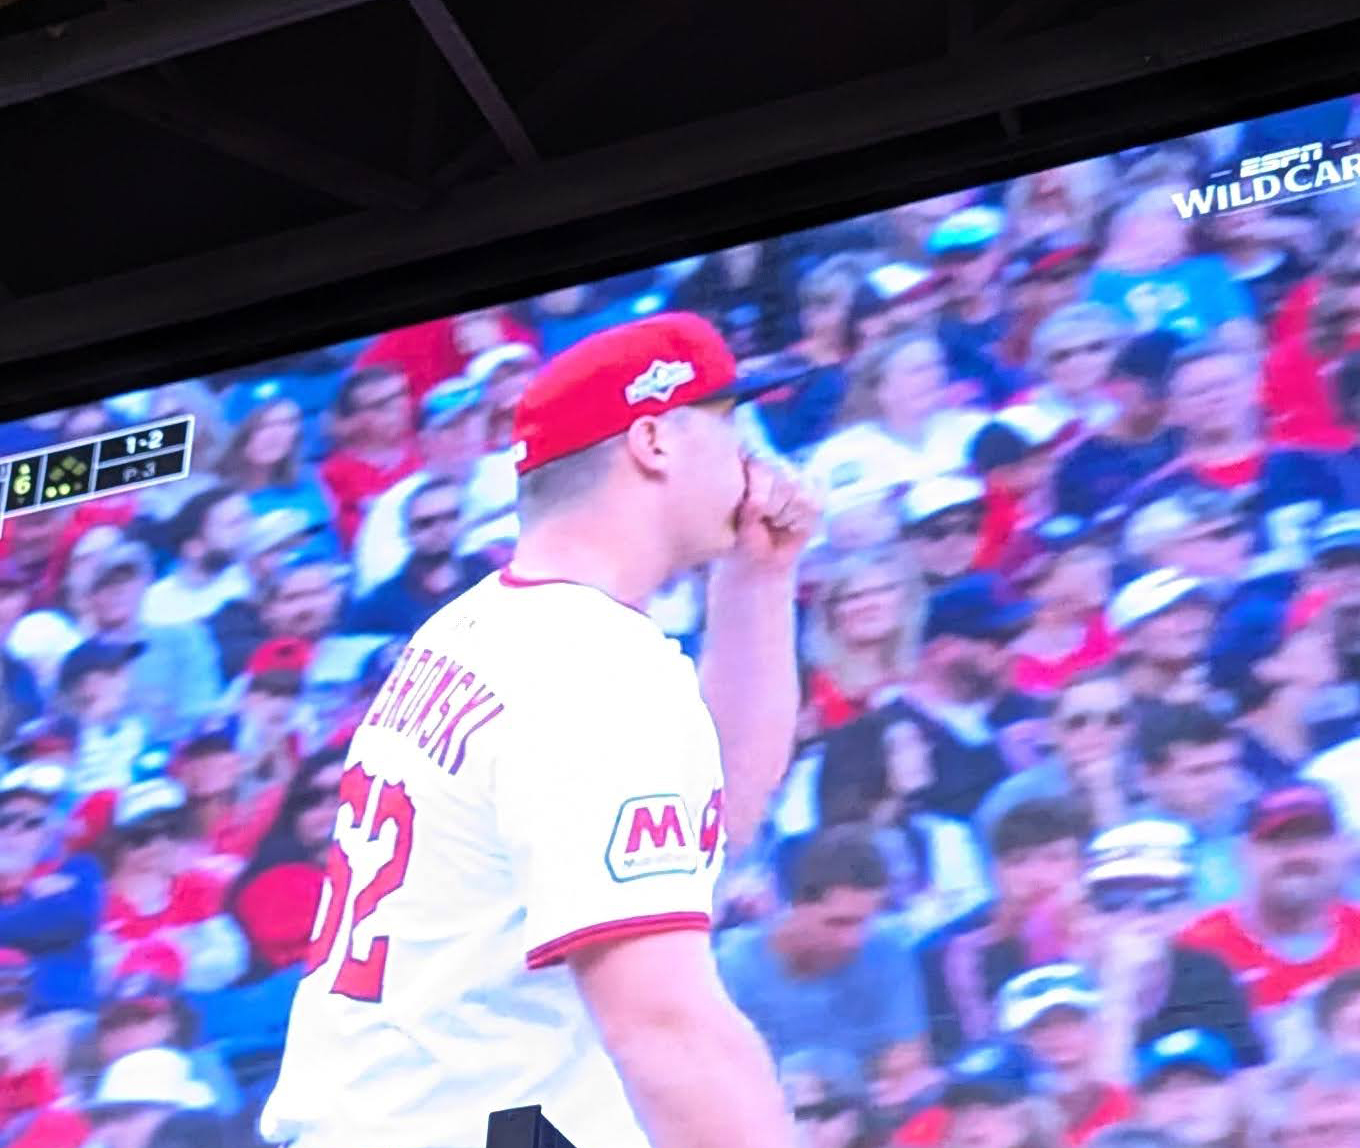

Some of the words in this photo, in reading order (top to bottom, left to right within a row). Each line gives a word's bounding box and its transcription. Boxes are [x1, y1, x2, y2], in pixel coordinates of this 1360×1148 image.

[1240, 142, 1323, 178] ESPN
[123, 430, 165, 455] 1-2
[13, 474, 32, 496] 6
[625, 804, 686, 854] M
